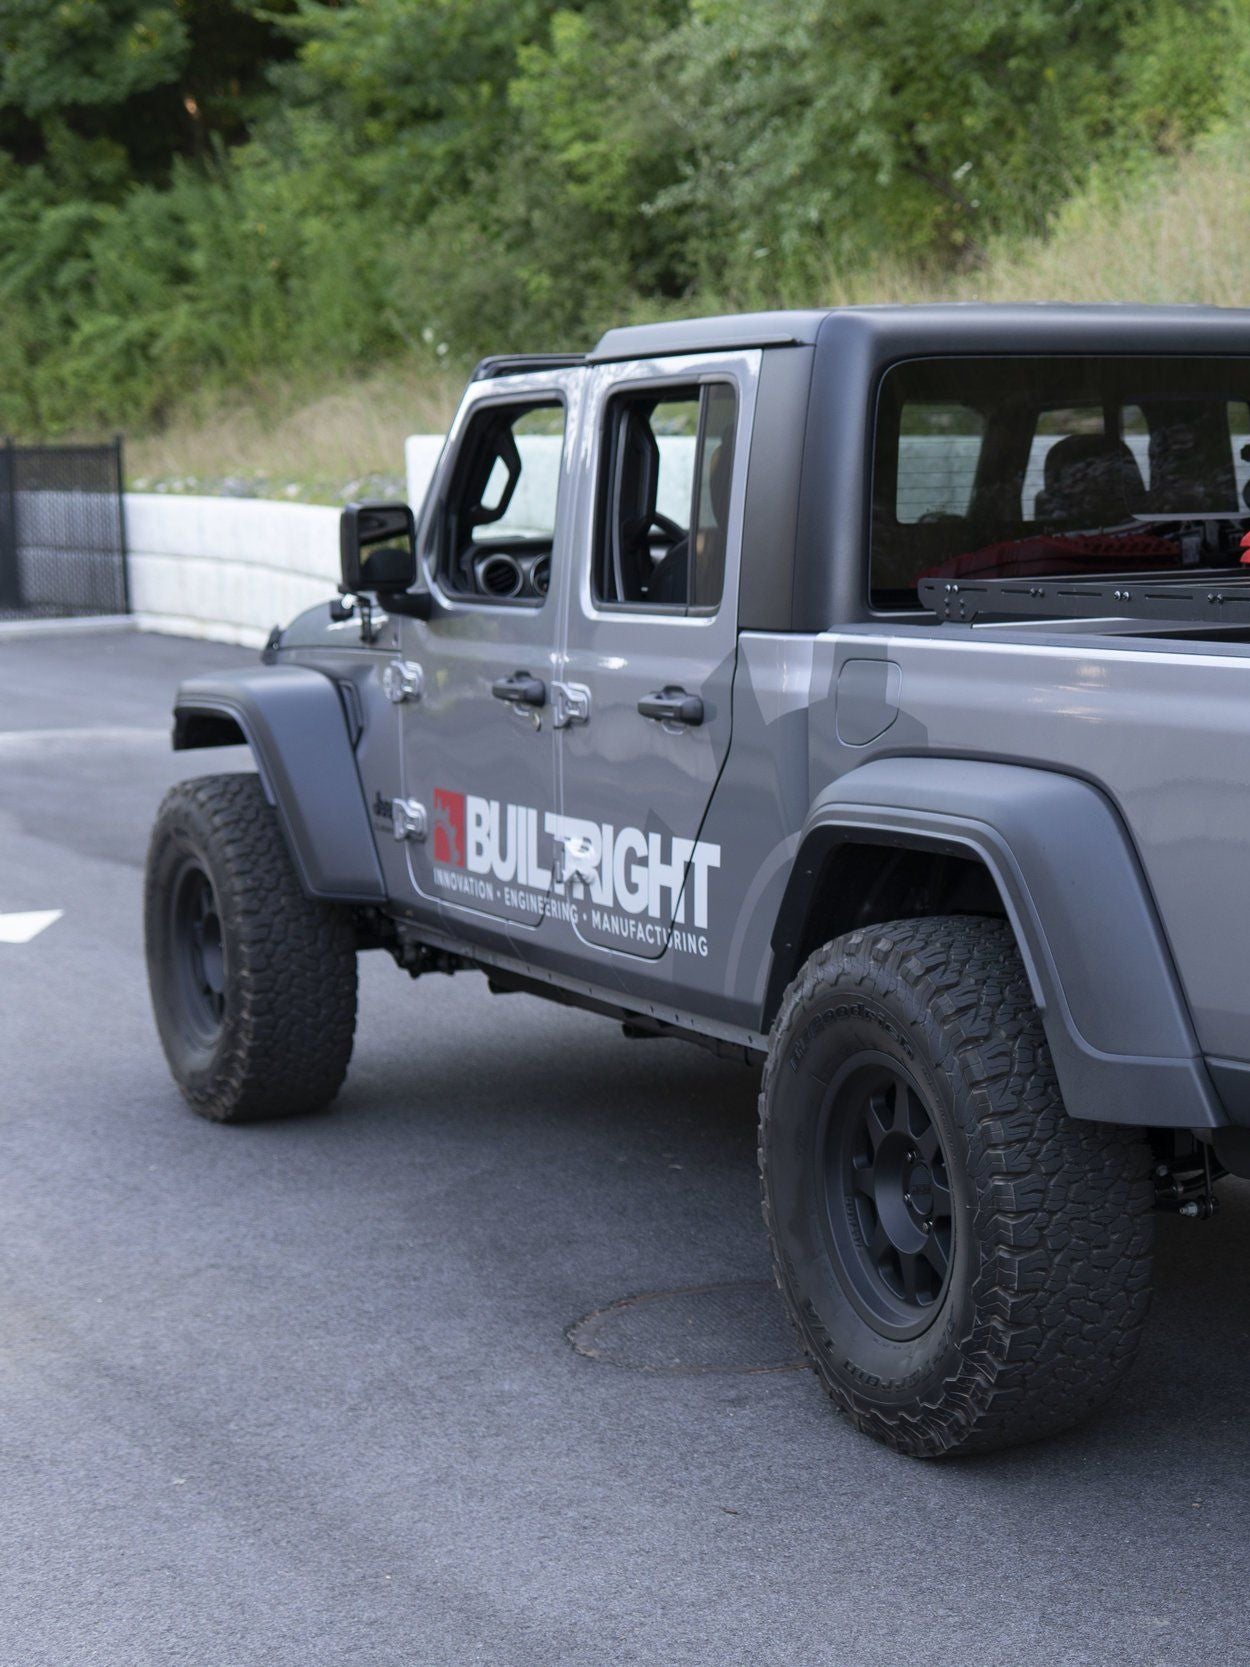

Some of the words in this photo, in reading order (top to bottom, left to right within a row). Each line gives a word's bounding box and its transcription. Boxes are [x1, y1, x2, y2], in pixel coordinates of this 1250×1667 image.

[432, 867, 494, 900] INNOVATION
[503, 886, 578, 924] ENGINEERING
[590, 909, 709, 957] MANUFACTURING
[466, 794, 721, 929] BUILTRIGHT
